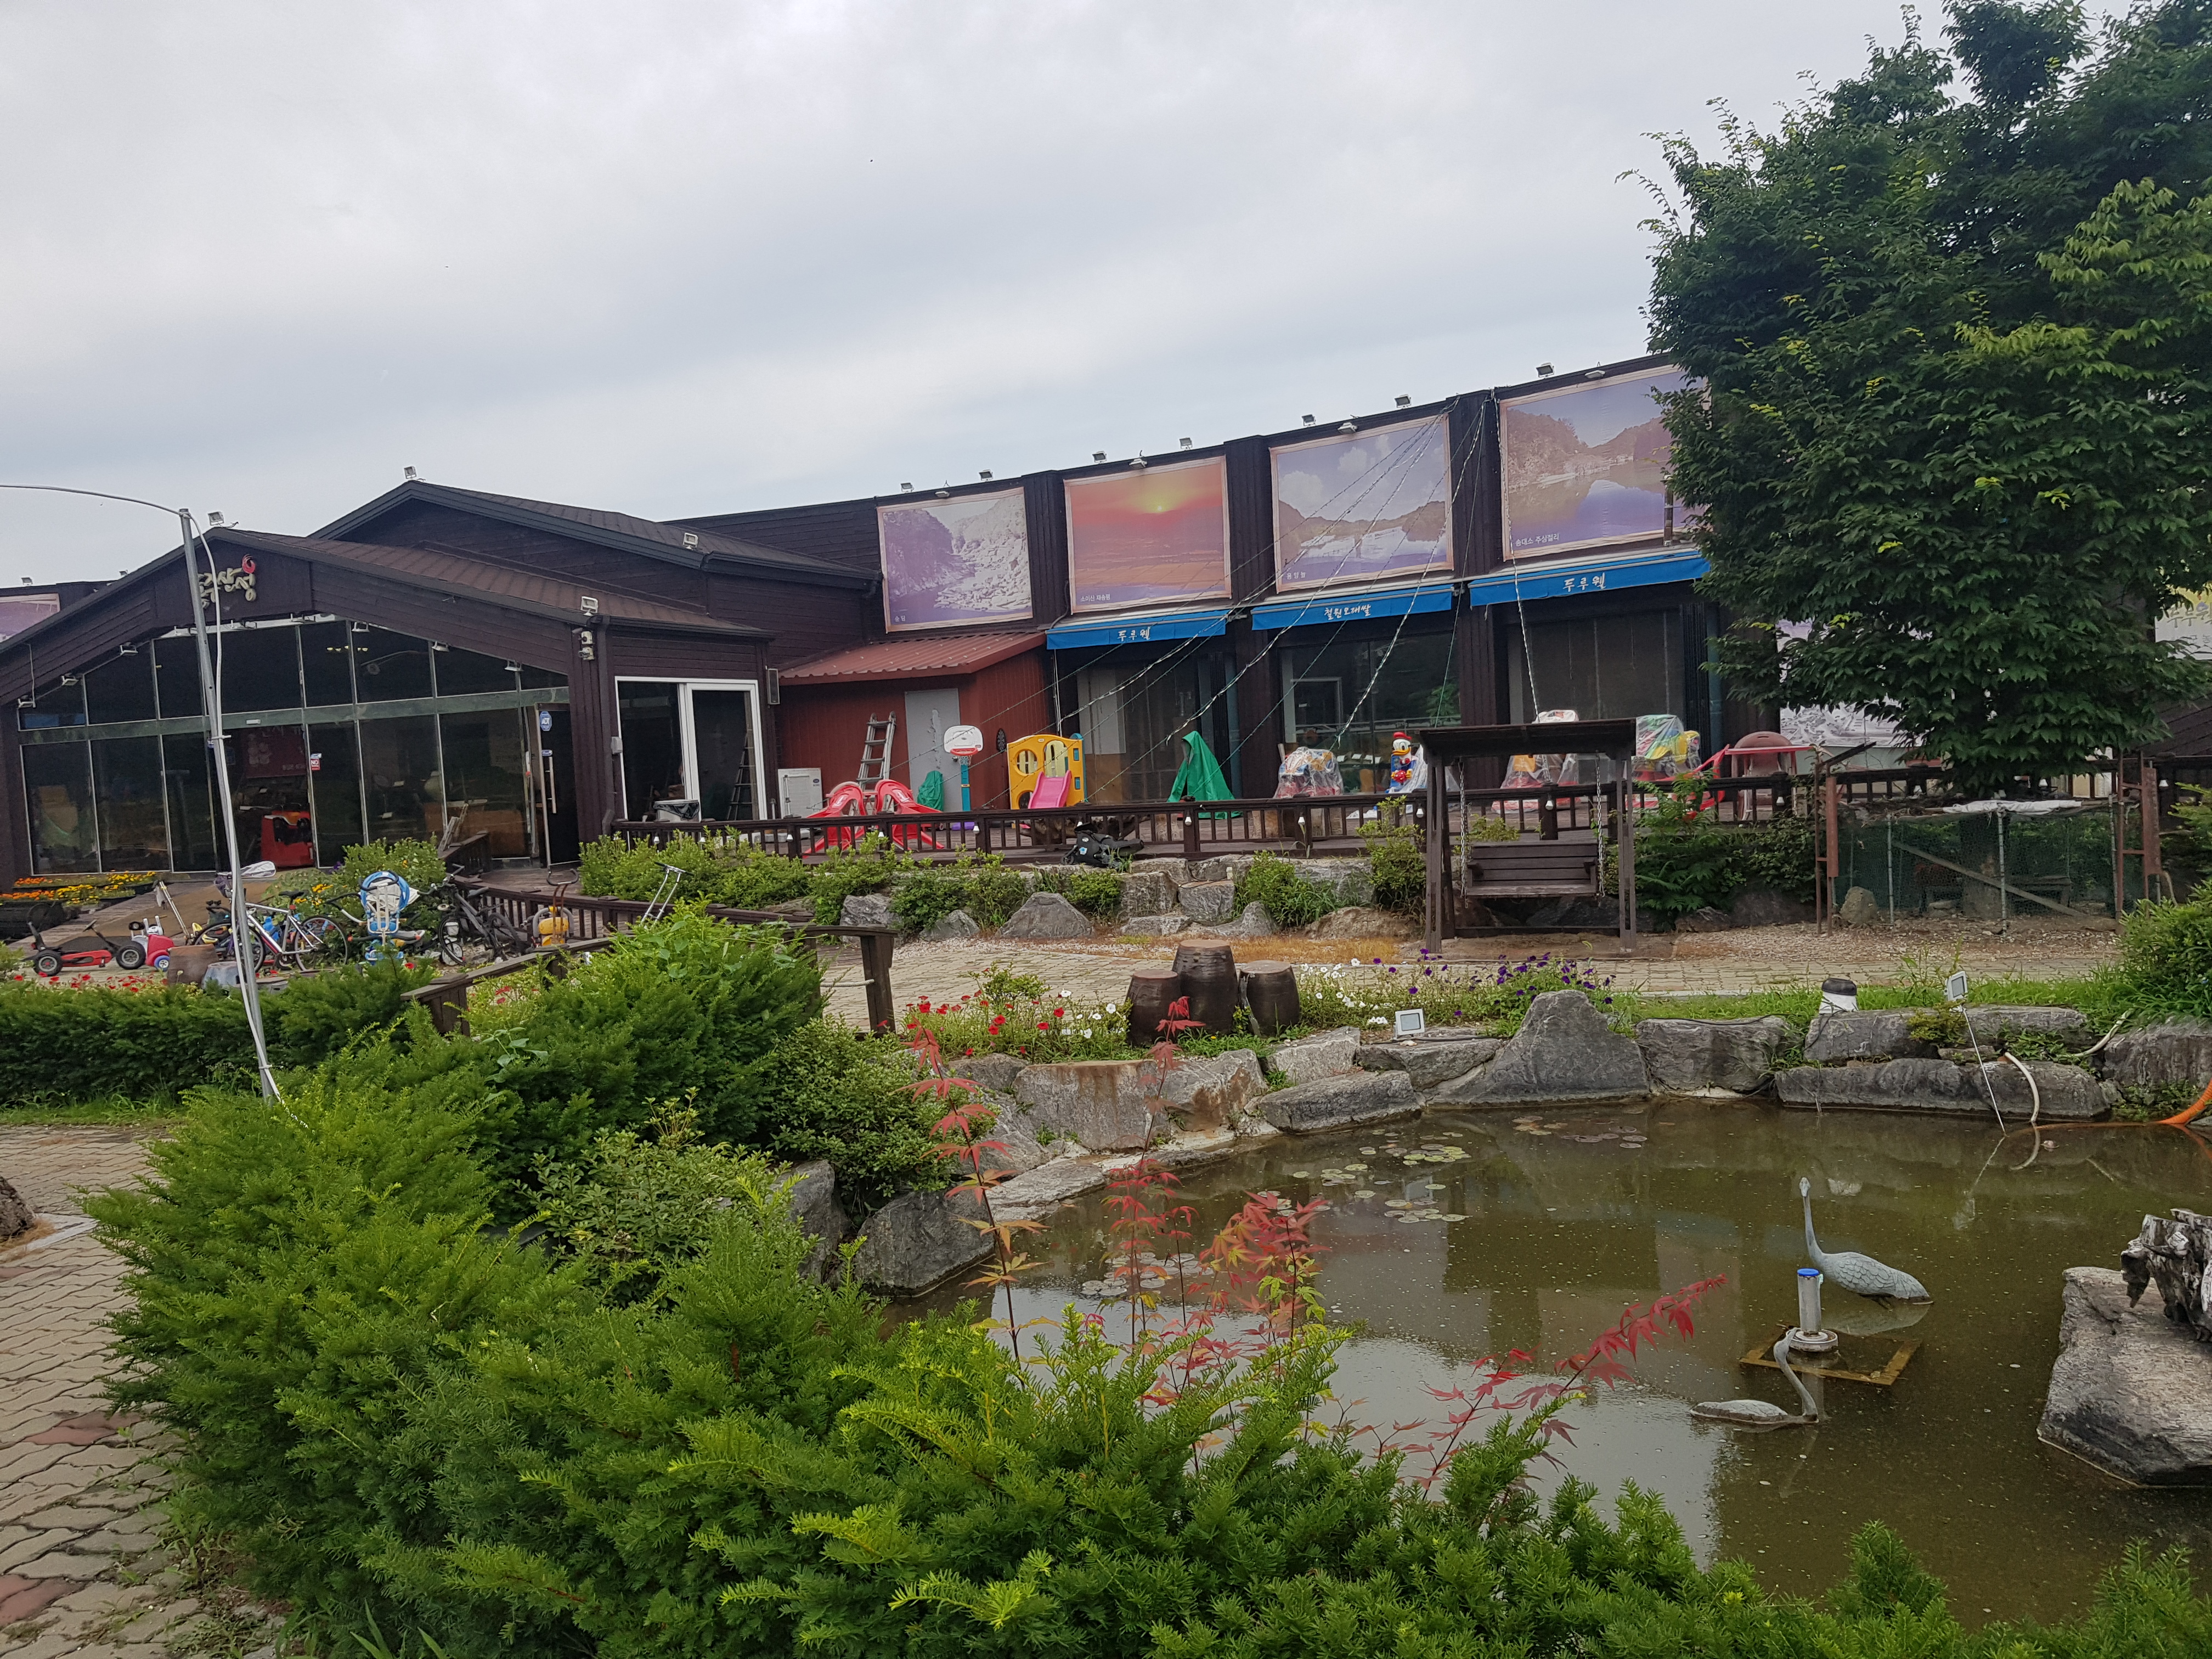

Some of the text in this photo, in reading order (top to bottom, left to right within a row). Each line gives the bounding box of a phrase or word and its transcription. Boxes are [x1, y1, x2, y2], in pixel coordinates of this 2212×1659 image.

[1515, 537, 1534, 546] 송대소
[1562, 572, 1607, 592] 두루웰
[1116, 626, 1151, 642] 두루웰
